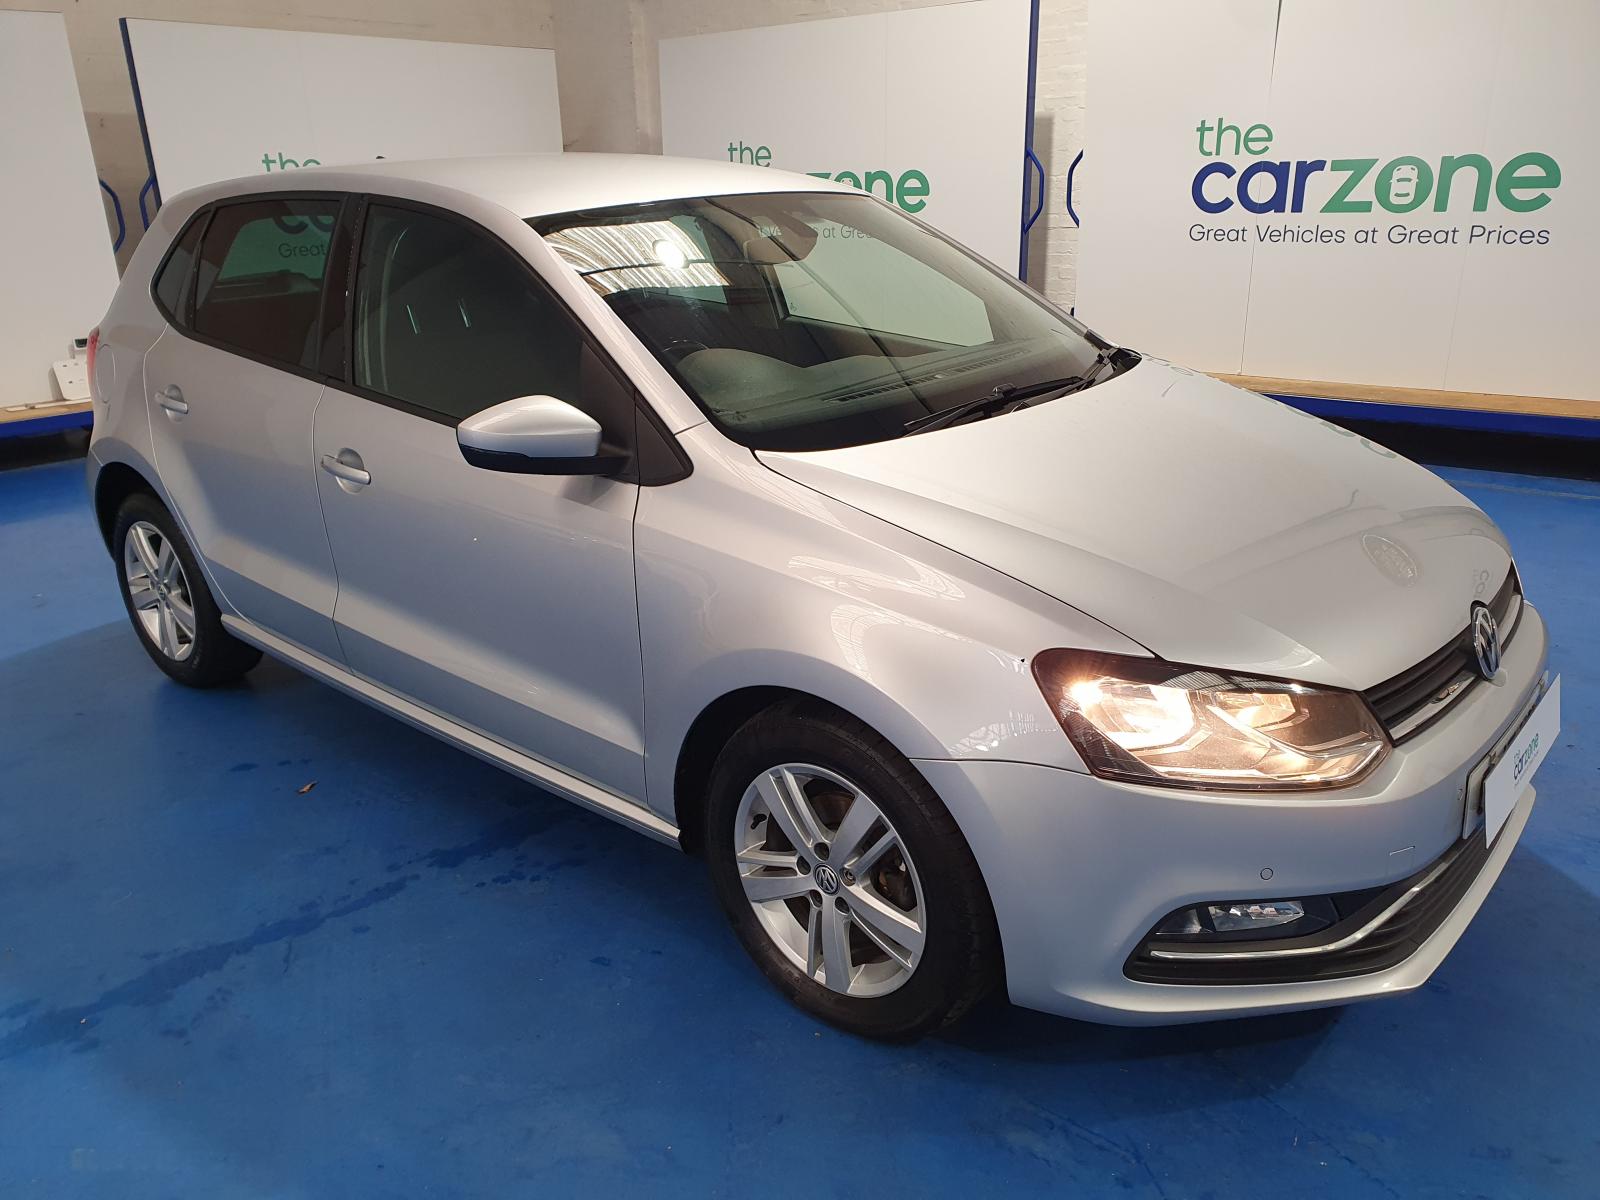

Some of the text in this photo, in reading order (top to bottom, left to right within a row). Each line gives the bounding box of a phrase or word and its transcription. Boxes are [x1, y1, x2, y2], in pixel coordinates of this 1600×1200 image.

[1196, 117, 1273, 156] the
[728, 140, 772, 168] the
[1191, 152, 1561, 214] carzone
[1188, 223, 1550, 245] Great Vehicles at Great Prices
